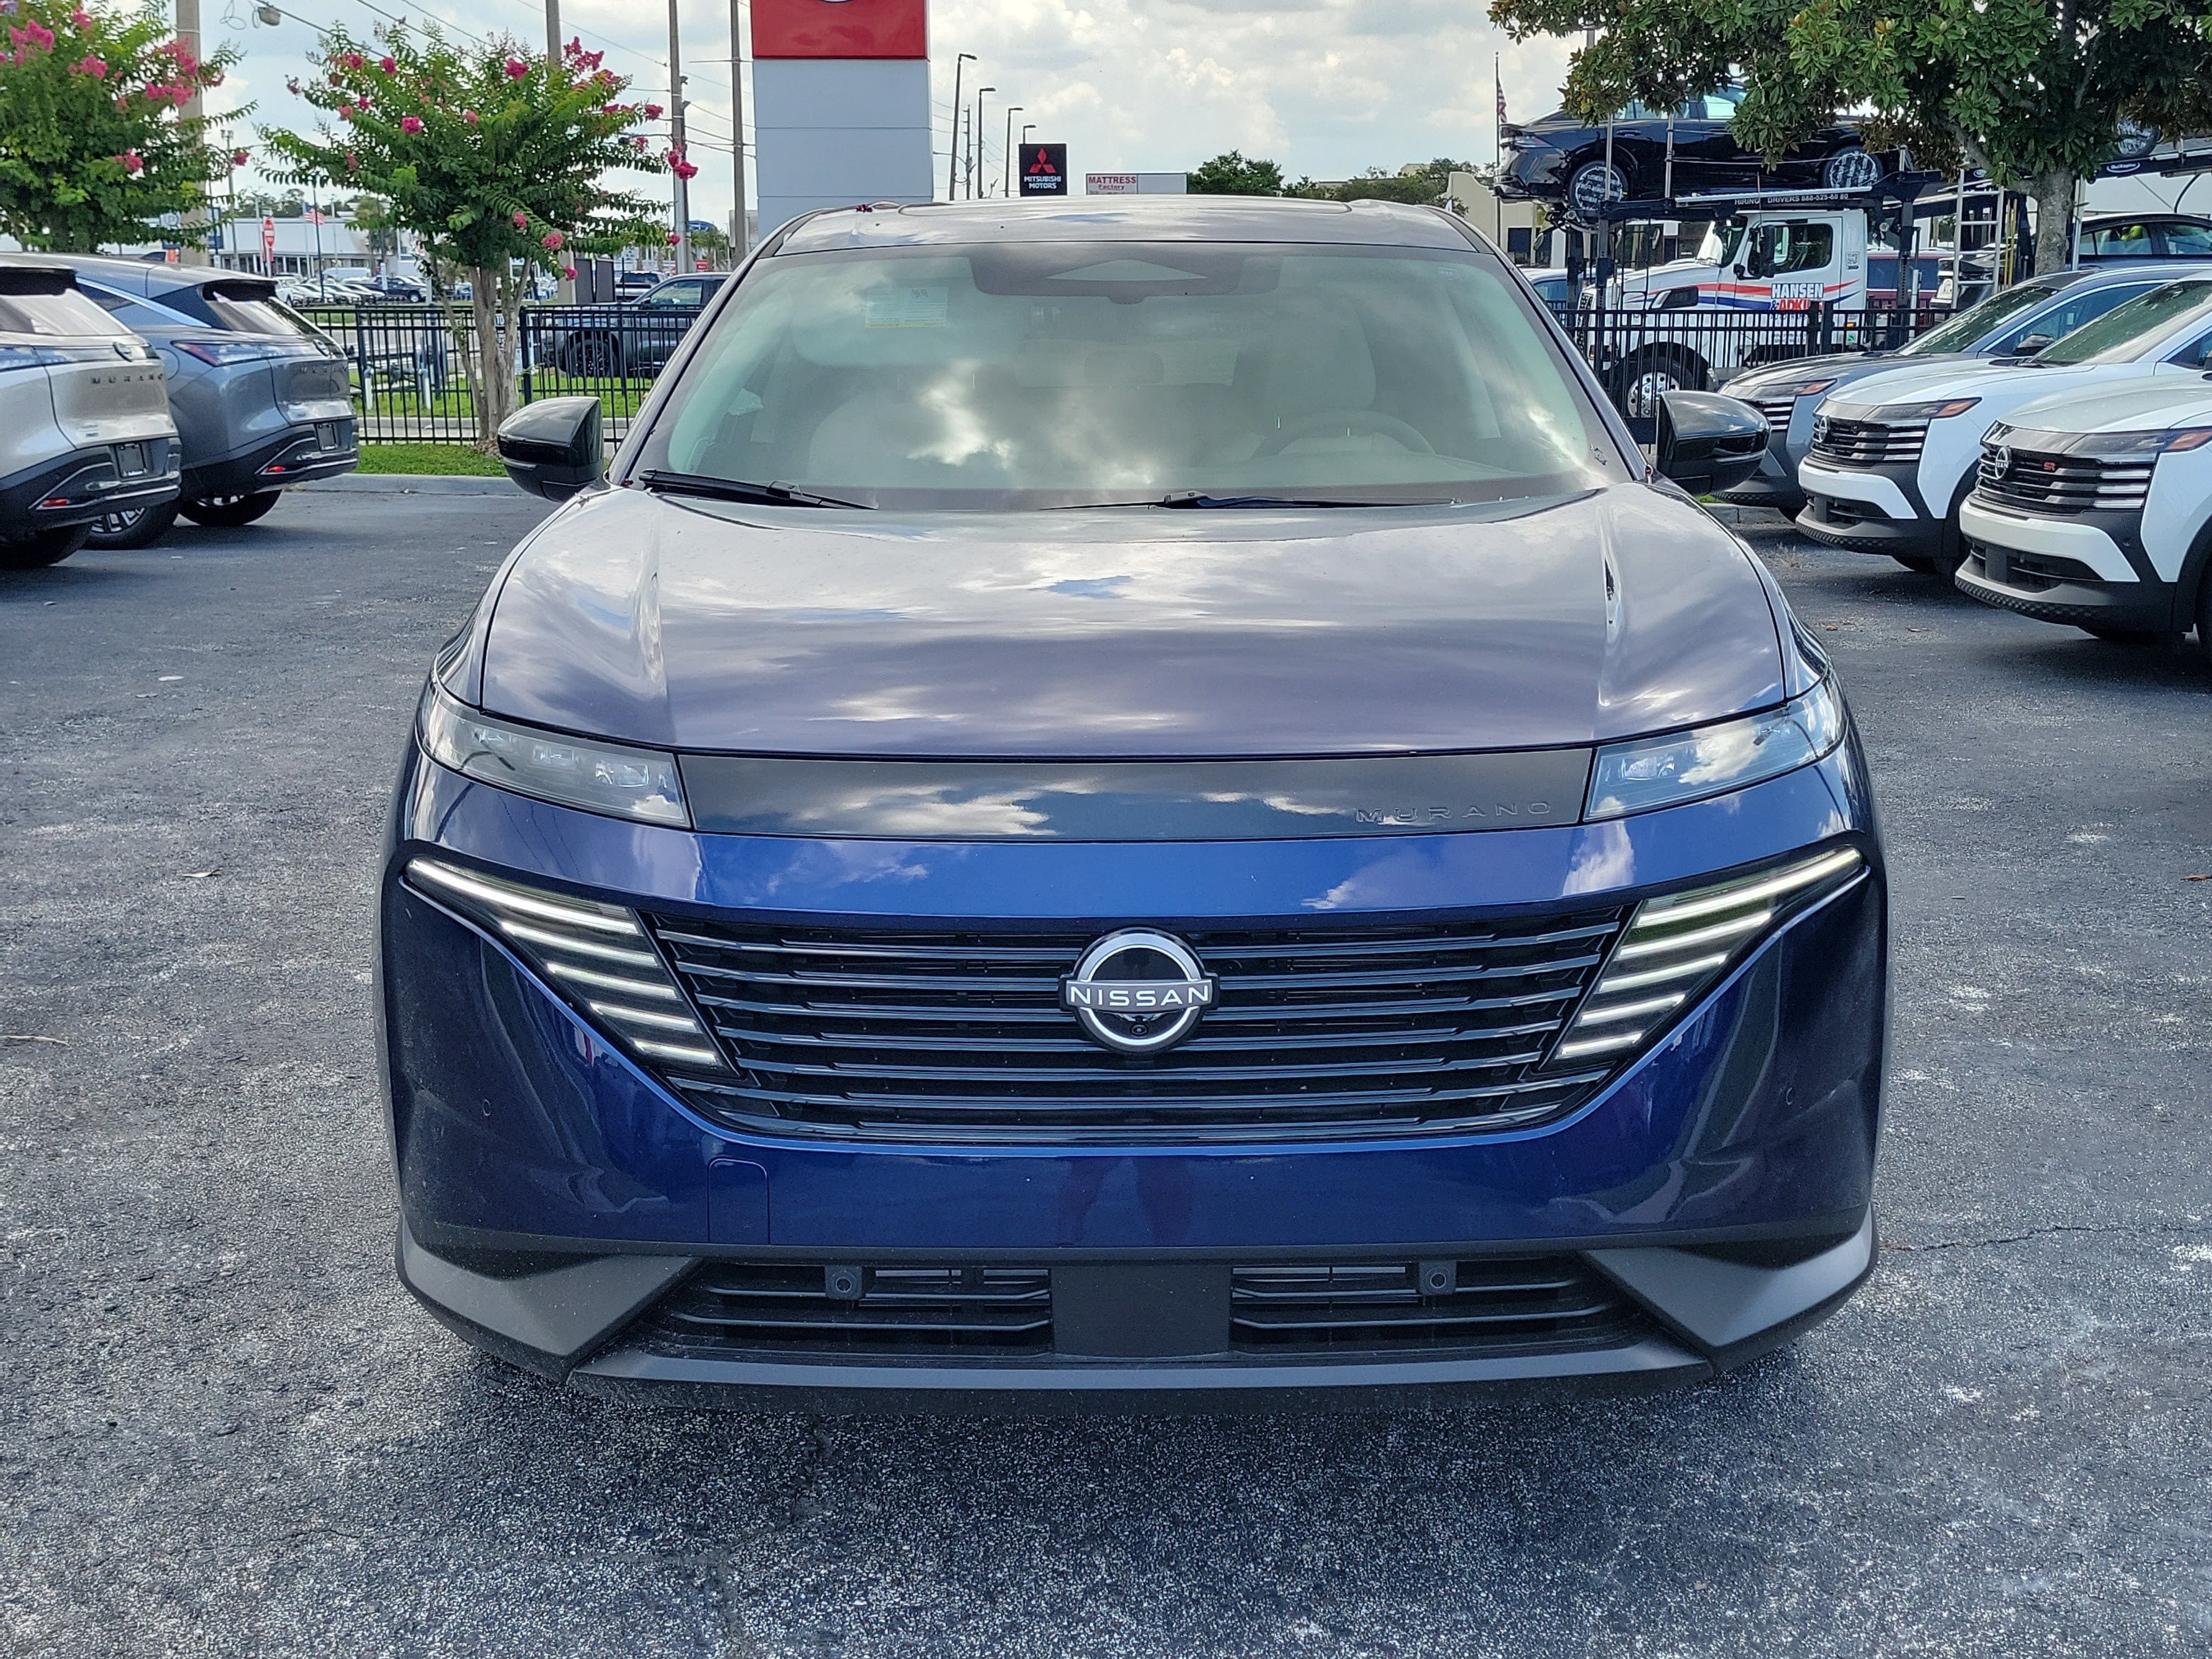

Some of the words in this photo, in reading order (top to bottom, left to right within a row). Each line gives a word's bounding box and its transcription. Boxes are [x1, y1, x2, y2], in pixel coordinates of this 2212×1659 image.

[1768, 195, 1800, 204] DRIVERS
[1771, 283, 1824, 298] HANSEN
[1356, 802, 1551, 823] MURANO
[1070, 985, 1209, 1007] NISSAN
